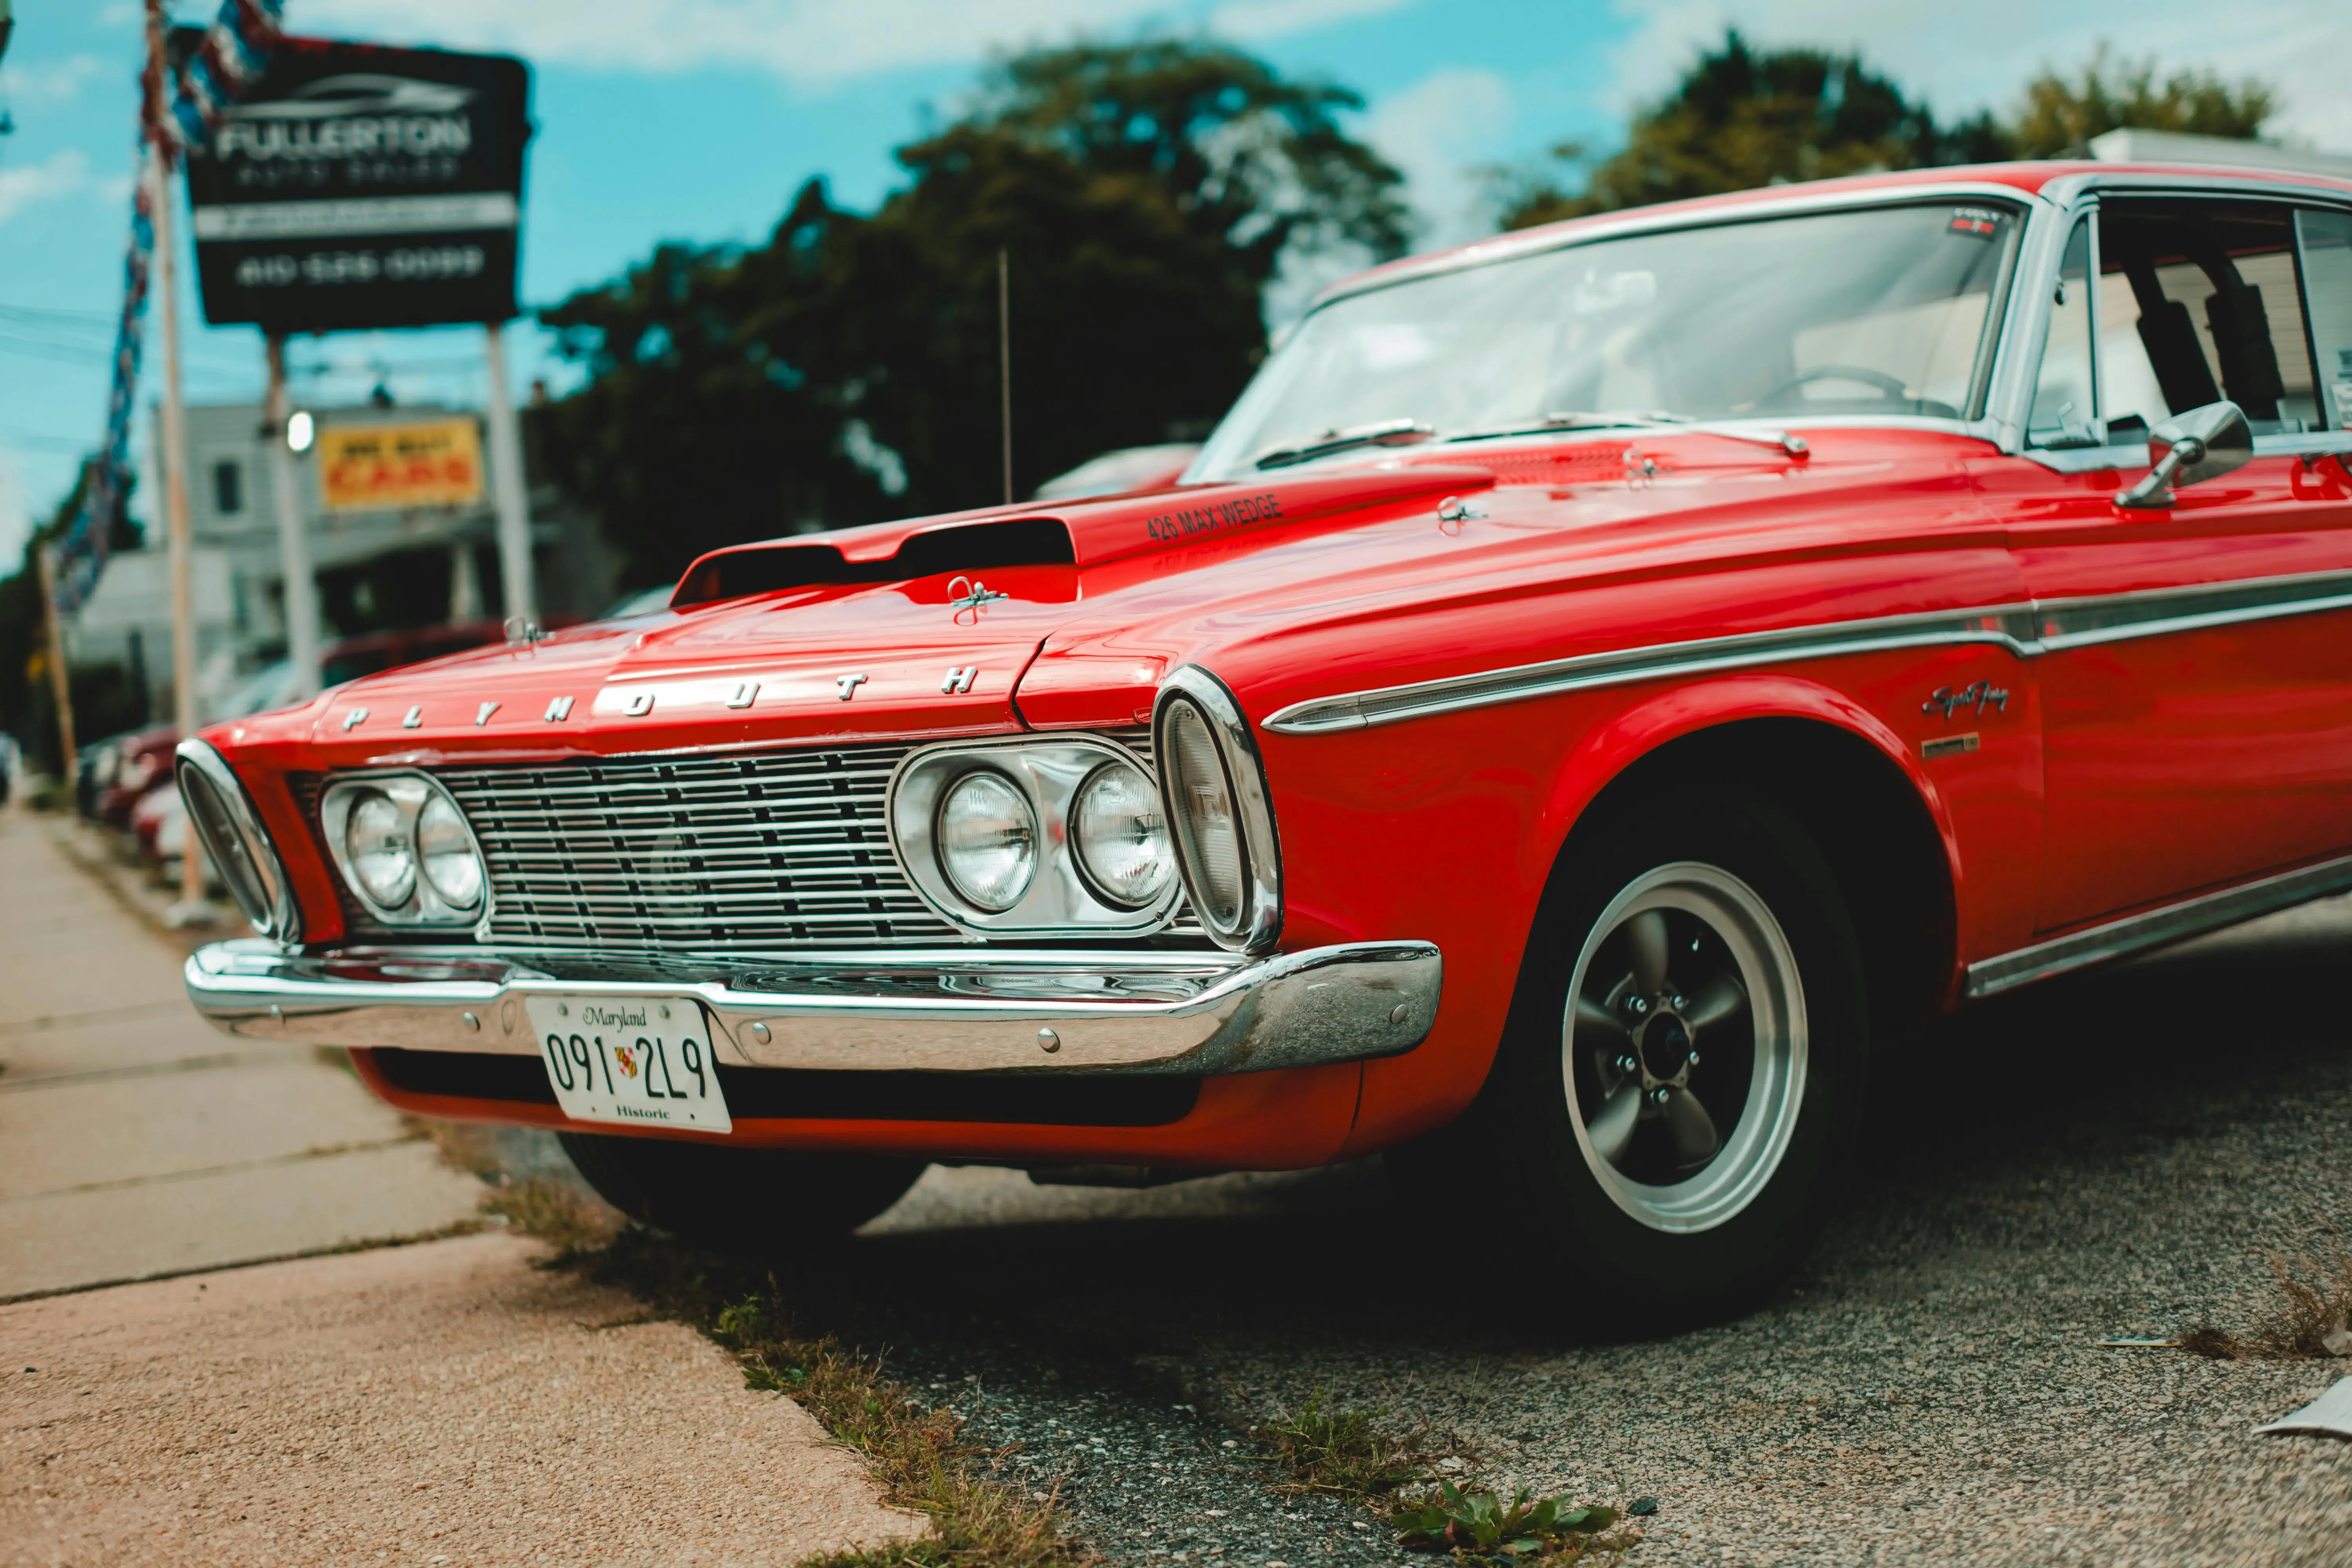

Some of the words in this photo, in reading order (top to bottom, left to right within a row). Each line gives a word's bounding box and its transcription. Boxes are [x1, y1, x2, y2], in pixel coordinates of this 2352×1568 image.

[217, 116, 470, 160] FULLERTON
[1147, 515, 1179, 541] 426
[1177, 506, 1220, 535] MAX
[1217, 494, 1283, 527] WEDGE
[343, 666, 978, 731] PLYMOUTH
[583, 1006, 647, 1033] Maryland
[547, 1034, 615, 1095] 091
[636, 1037, 706, 1098] 2L9
[617, 1105, 670, 1119] Historic
